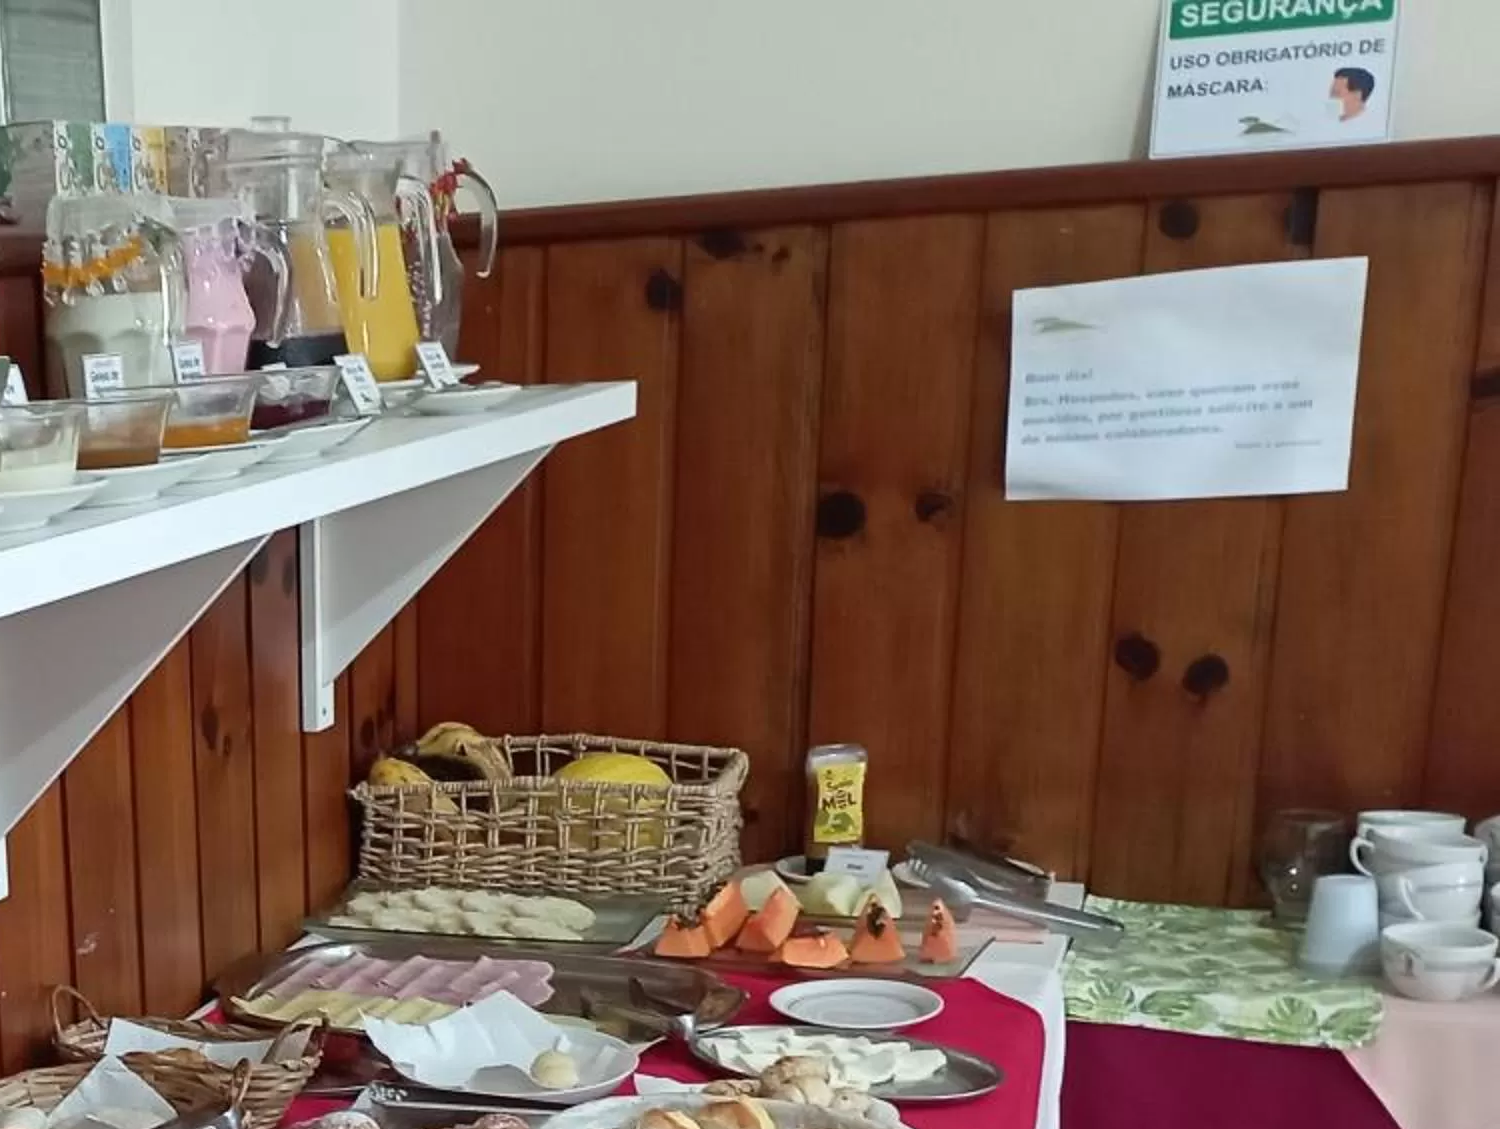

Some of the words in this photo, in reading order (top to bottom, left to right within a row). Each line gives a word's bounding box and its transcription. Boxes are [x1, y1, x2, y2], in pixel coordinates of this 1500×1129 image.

[1170, 53, 1210, 70] USO
[1216, 40, 1353, 66] OBRIGATÓRIO
[1358, 38, 1385, 54] DE
